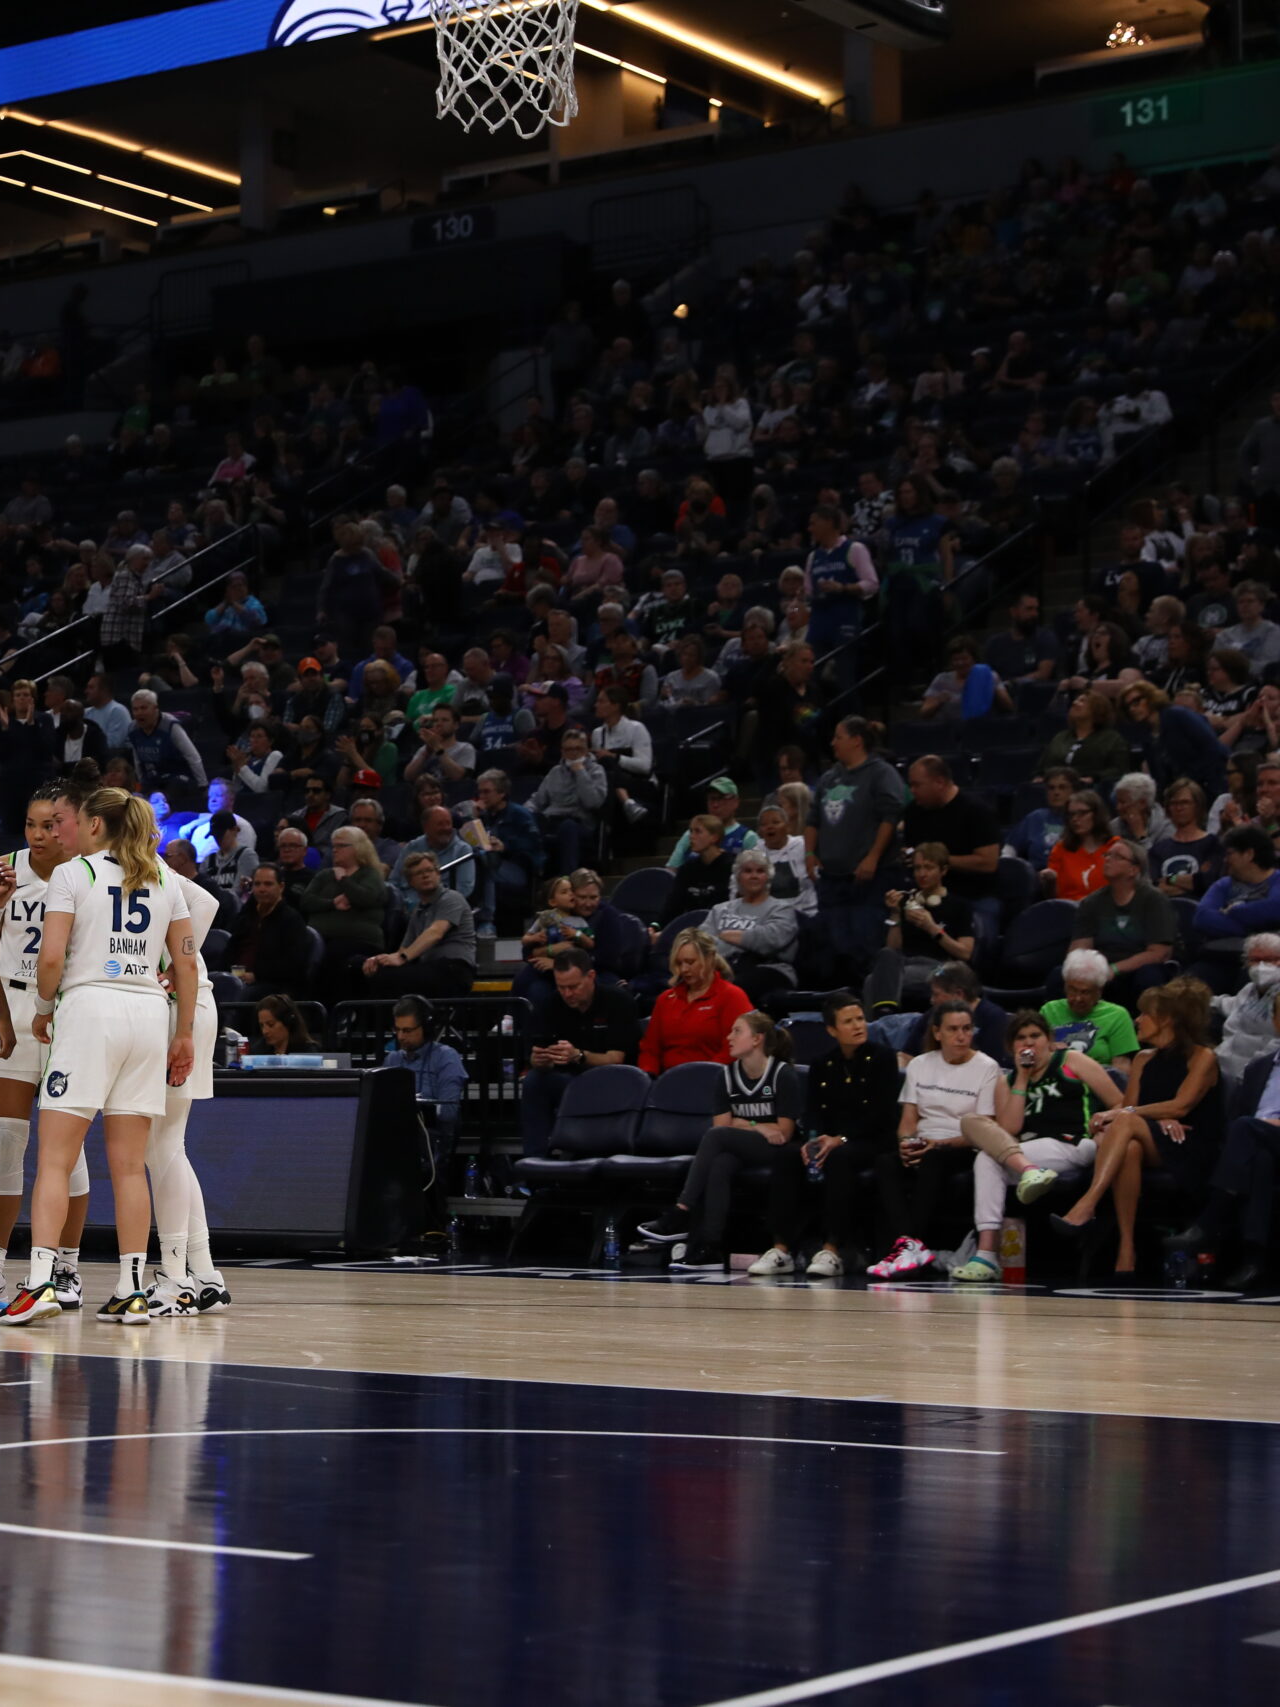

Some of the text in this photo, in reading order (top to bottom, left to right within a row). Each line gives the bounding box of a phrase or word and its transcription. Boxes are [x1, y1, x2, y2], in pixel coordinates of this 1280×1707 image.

[1120, 94, 1169, 127] 131
[431, 214, 474, 241] 130
[12, 900, 45, 922] LY
[108, 886, 151, 934] 15
[23, 926, 42, 954] 2
[110, 937, 147, 956] BANHAM
[124, 963, 149, 976] AT&T
[732, 1103, 774, 1117] MINN
